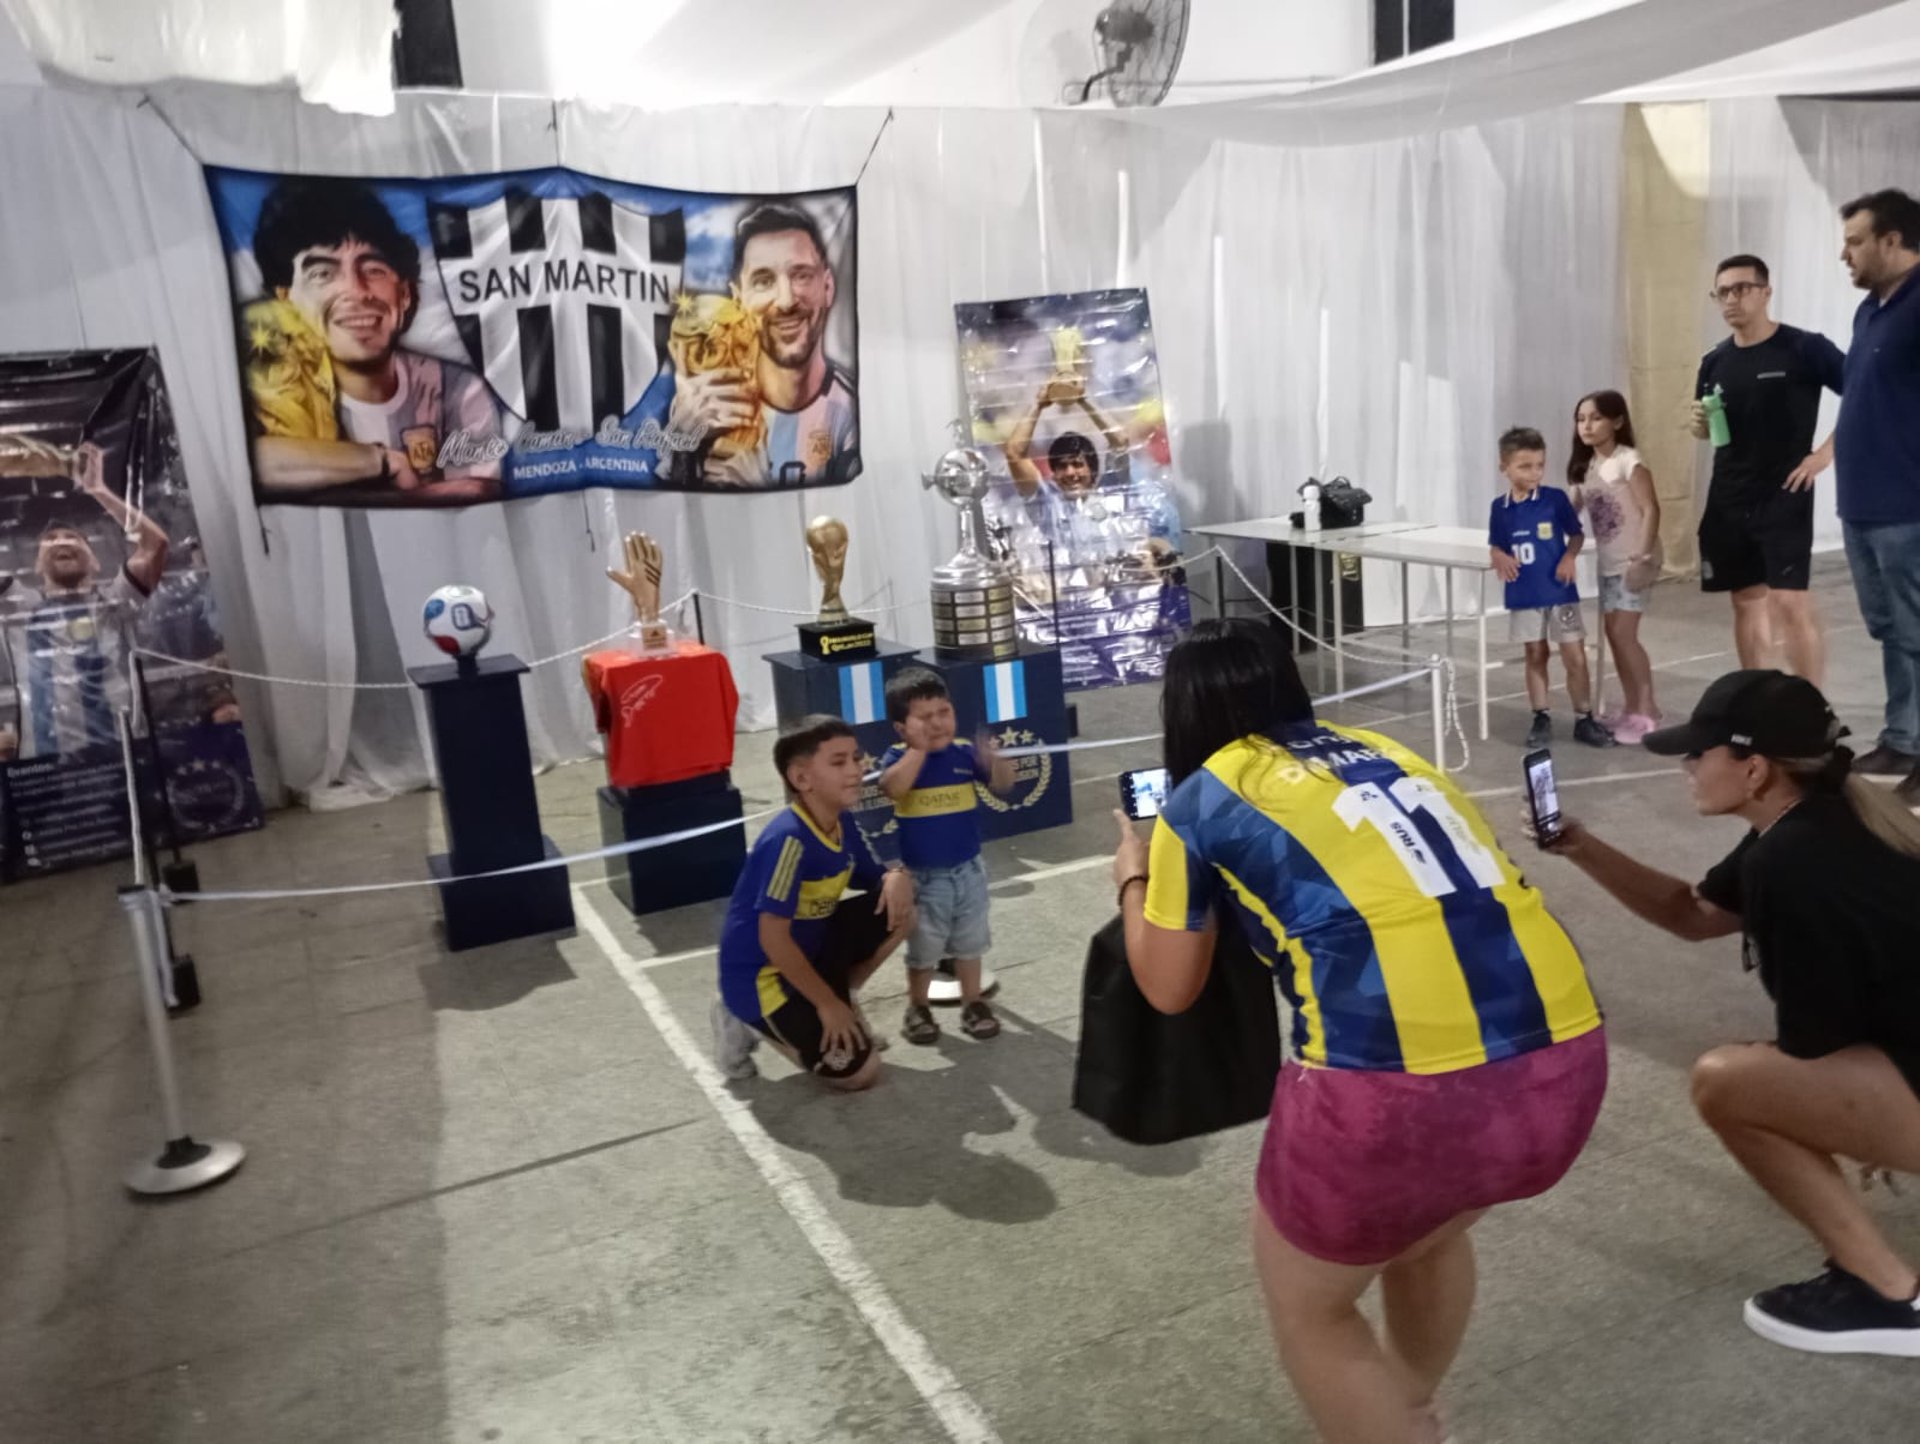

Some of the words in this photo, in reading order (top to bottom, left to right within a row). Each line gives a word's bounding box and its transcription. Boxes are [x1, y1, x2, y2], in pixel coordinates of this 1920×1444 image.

[459, 263, 531, 303] SAN
[544, 259, 670, 303] MARTIN
[513, 460, 577, 480] MENDOZA
[584, 457, 649, 473] ARGENTINA
[1511, 542, 1536, 565] 10
[1331, 776, 1507, 899] 11
